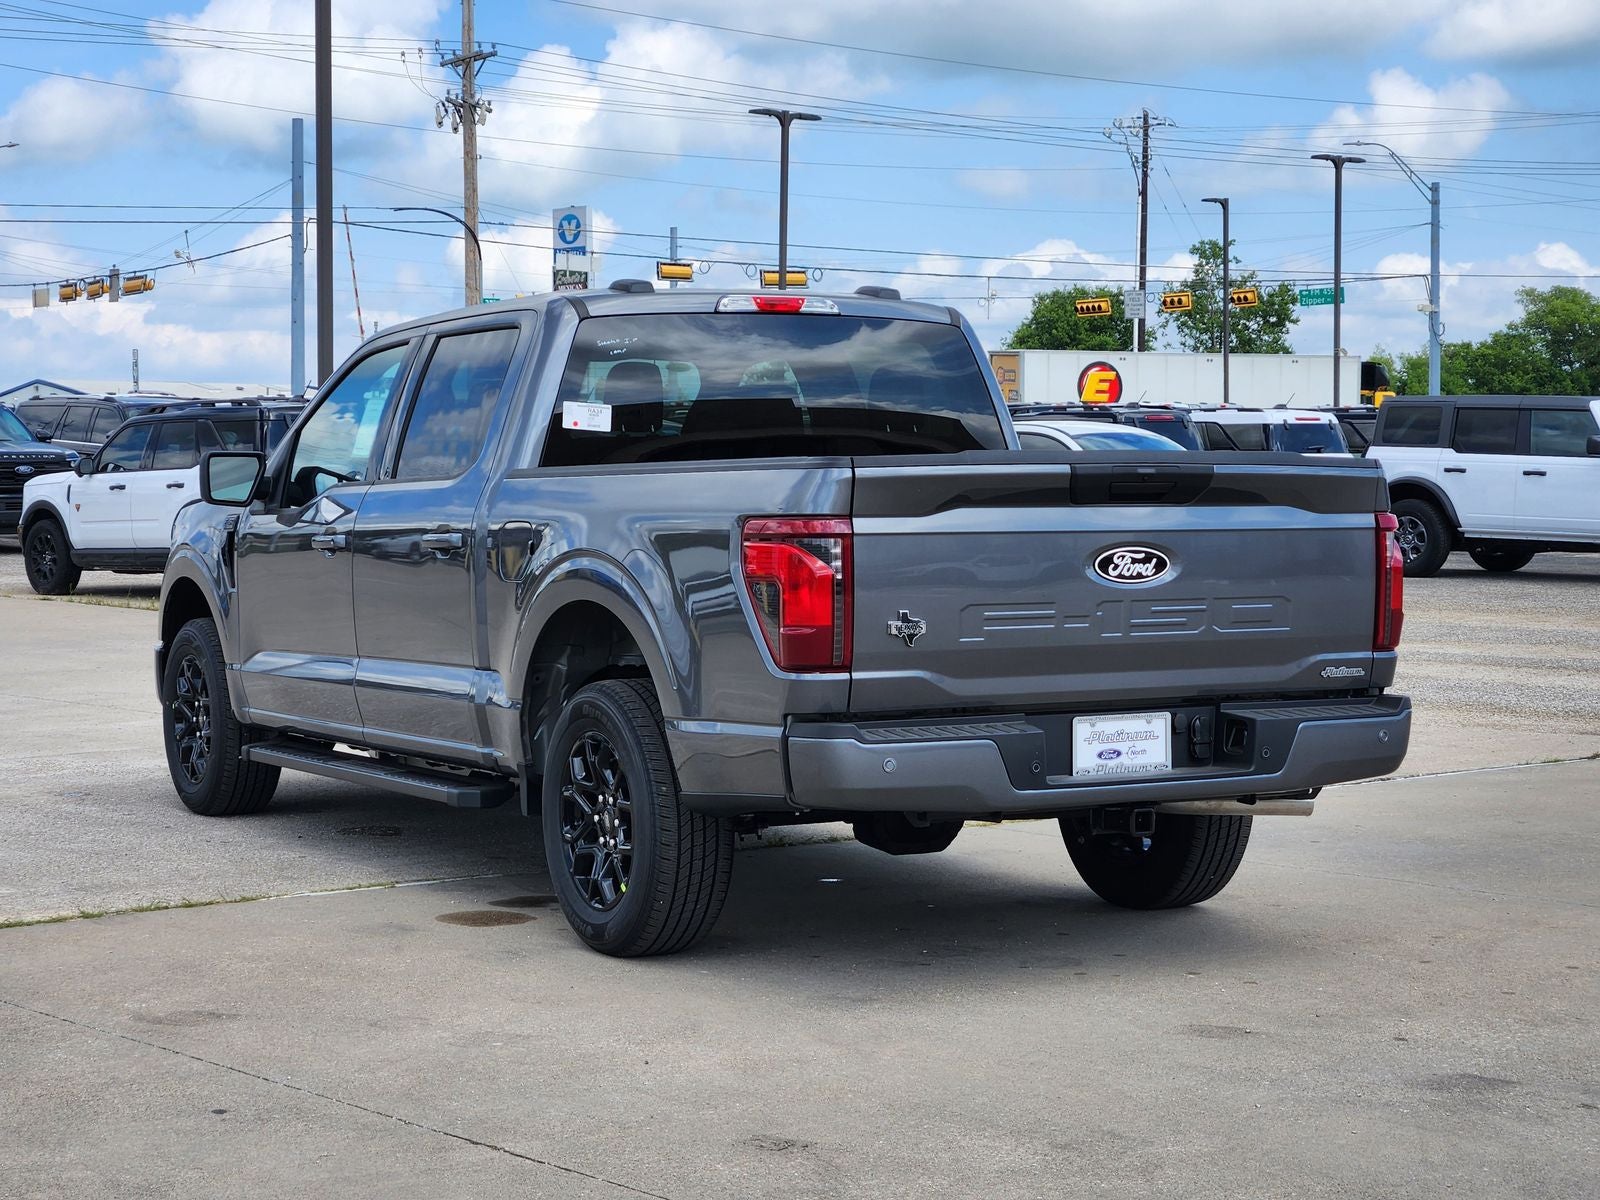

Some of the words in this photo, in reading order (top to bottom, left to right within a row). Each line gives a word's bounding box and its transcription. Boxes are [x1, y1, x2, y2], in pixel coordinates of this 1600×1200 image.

[1301, 297, 1325, 306] Zipper
[1081, 371, 1117, 402] E
[1105, 550, 1158, 579] Ford
[959, 596, 1292, 642] F-150
[894, 621, 926, 632] TEXAS
[1320, 666, 1366, 678] Platinum
[1083, 729, 1159, 745] Platinum
[1130, 748, 1147, 756] North
[1094, 761, 1151, 775] Platinum
